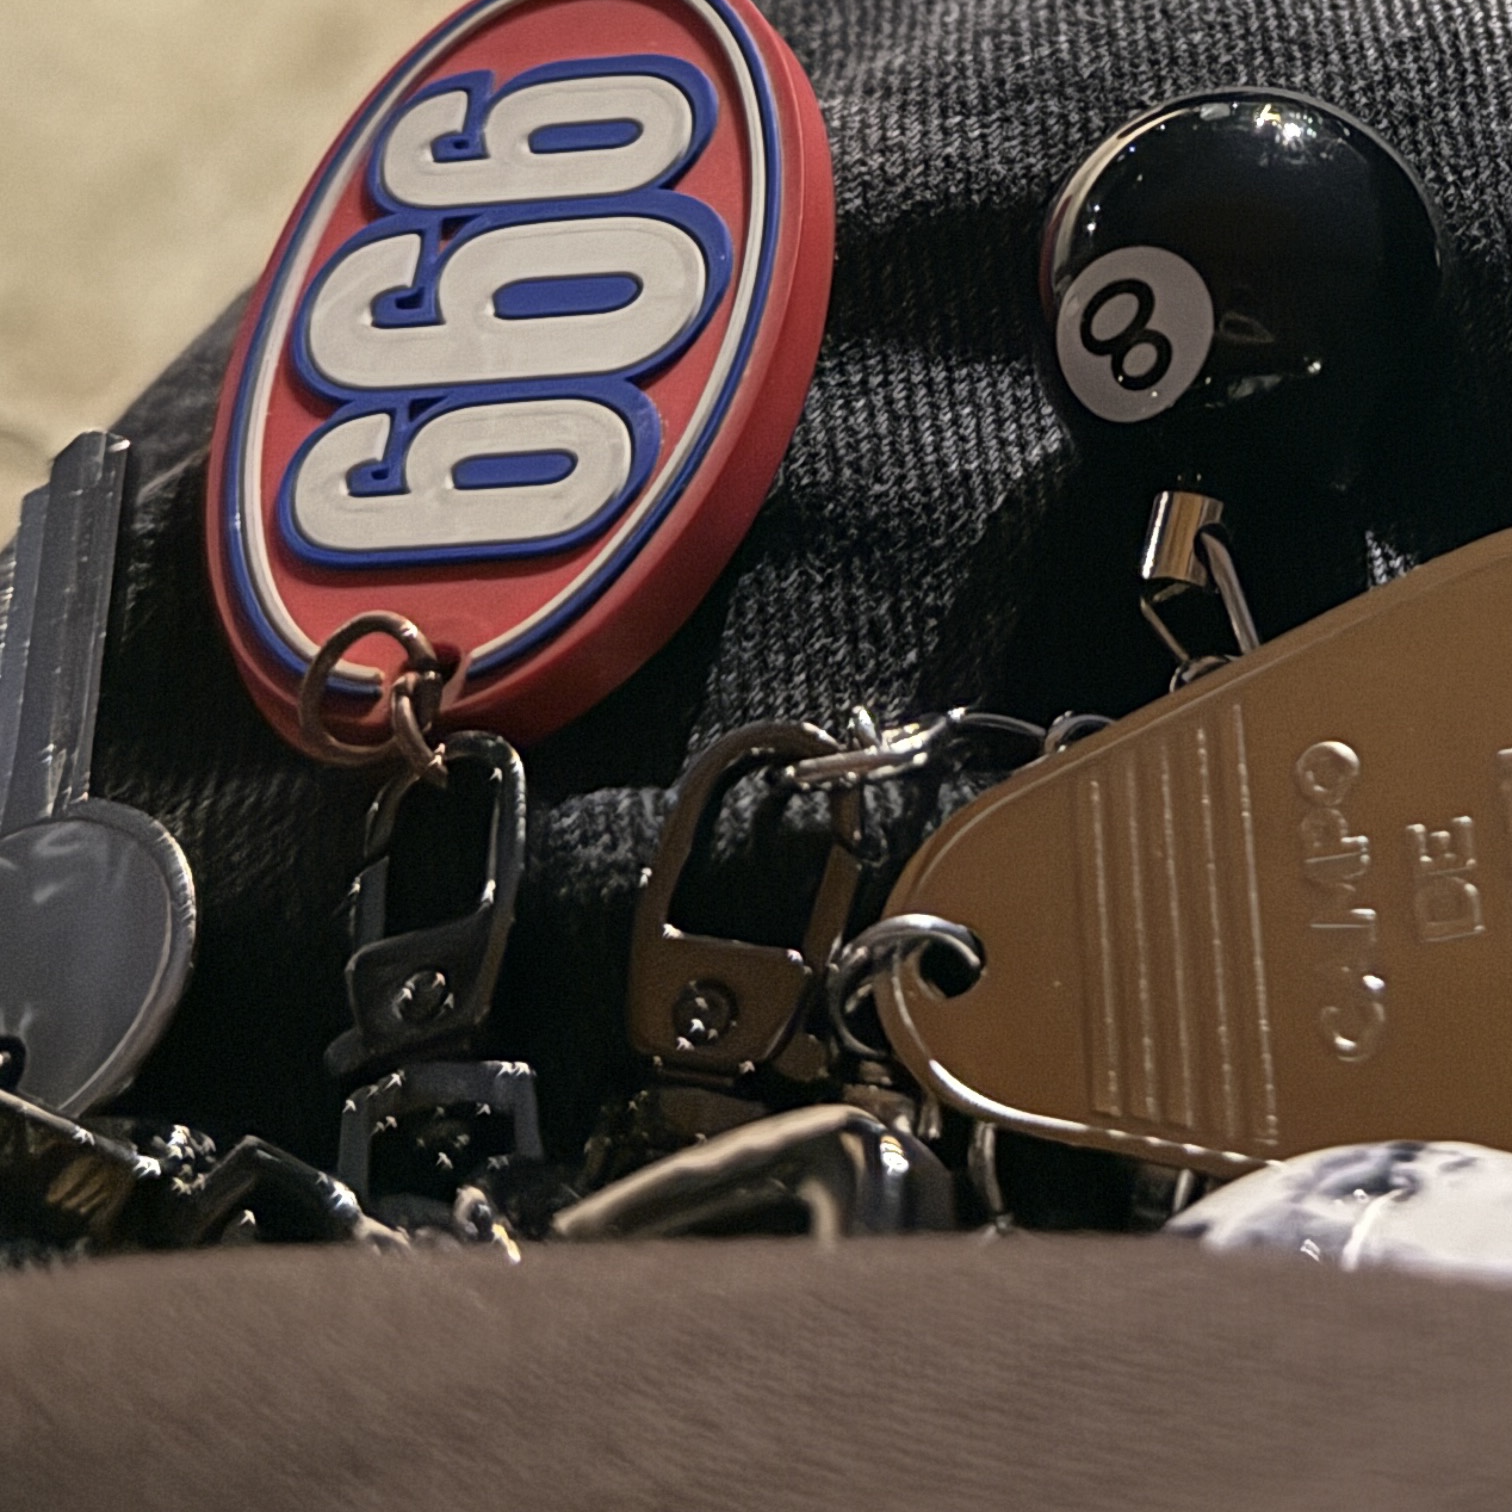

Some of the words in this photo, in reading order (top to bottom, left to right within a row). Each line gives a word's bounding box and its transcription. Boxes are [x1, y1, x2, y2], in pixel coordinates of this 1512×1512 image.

[1079, 277, 1173, 391] 8
[1297, 740, 1388, 1063] CAMPO
[1405, 814, 1486, 944] DE
